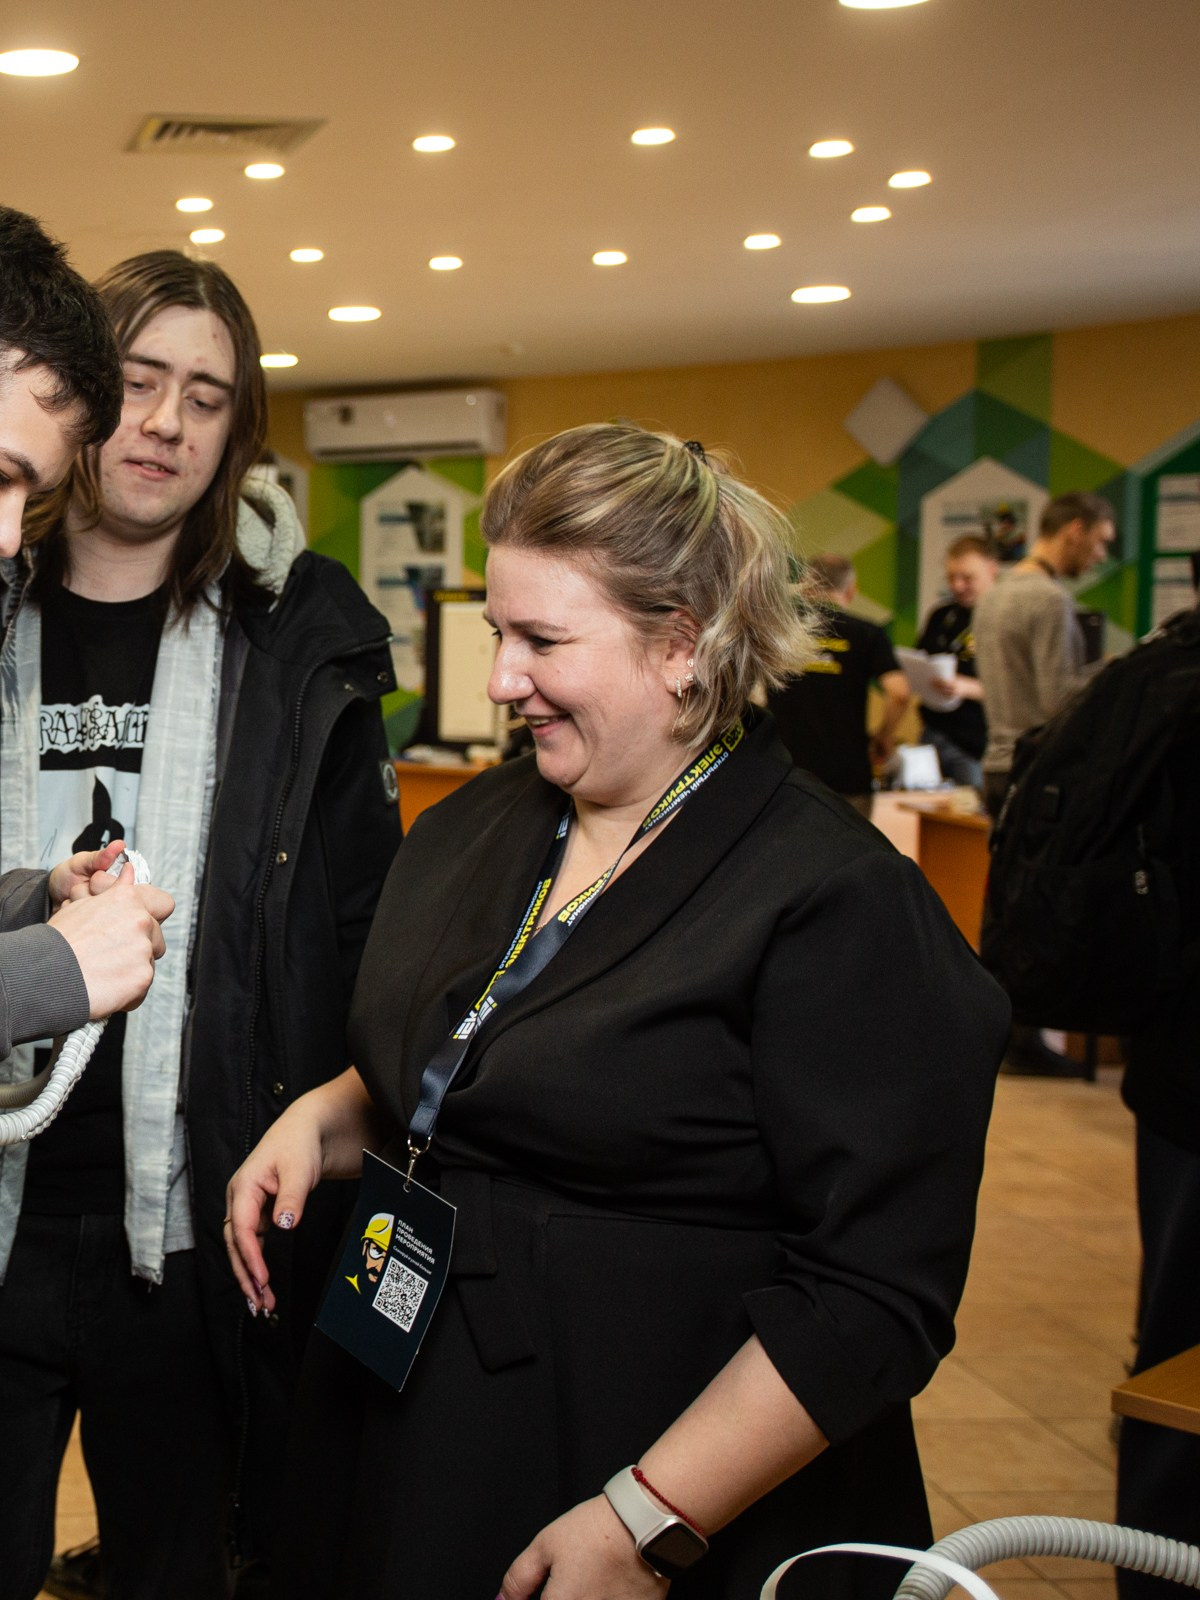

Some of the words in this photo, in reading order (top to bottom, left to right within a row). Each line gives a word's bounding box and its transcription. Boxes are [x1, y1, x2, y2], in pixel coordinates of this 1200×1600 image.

[642, 743, 723, 828] ЭЛЕКТРИКОВ
[690, 751, 729, 792] ОТКРЫТЫЙ
[644, 790, 691, 832] ЧЕМПИОНАТ
[499, 927, 523, 969] ОТКРЫТЫЙ
[520, 881, 543, 927] ЧЕМПИОНАТ
[505, 878, 552, 968] ЭЛЕКТРИКОВ
[396, 1226, 433, 1255] ПРОВЕДЕНИЯ
[397, 1219, 414, 1234] ПЛАН
[395, 1233, 436, 1264] МЕРОПРИЯТИЯ
